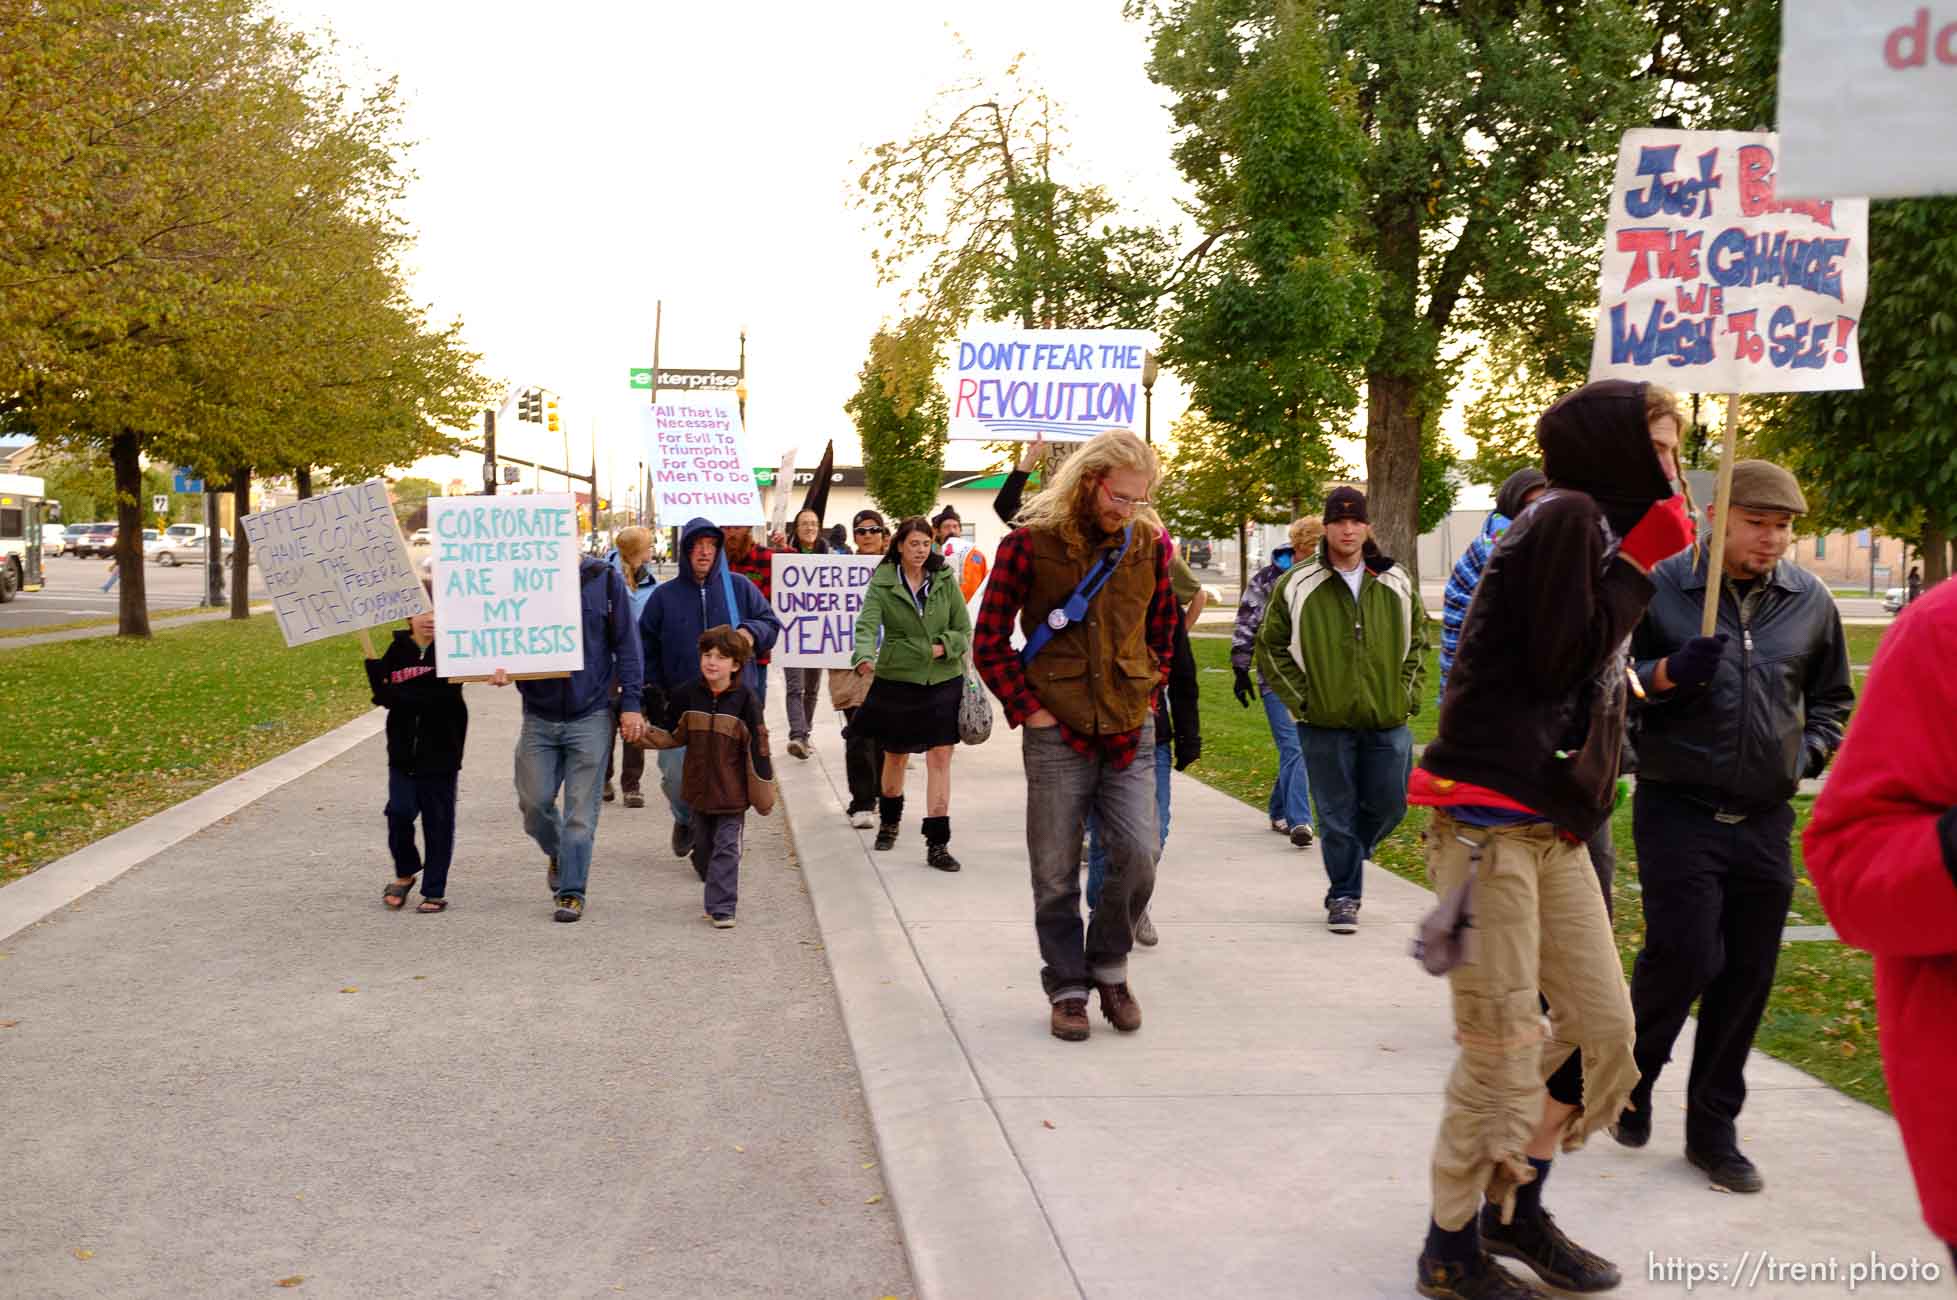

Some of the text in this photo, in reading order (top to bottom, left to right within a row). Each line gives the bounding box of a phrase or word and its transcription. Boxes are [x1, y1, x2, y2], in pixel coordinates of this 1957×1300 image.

[1616, 227, 1704, 294] THE
[1676, 283, 1724, 316] WE
[958, 341, 1142, 371] DON'T FEAR THE
[678, 406, 712, 418] That
[715, 408, 728, 418] Is
[955, 378, 1137, 423] REVOLUTION
[656, 418, 730, 431] Necessary
[658, 432, 734, 444] For Evil To
[658, 444, 737, 457] Triumph Is
[662, 457, 740, 469] For Good
[656, 470, 749, 482] Men To Do
[247, 483, 388, 542] EFFECTIVE
[437, 507, 571, 539] CORPORATE
[319, 514, 393, 553] COMES
[440, 541, 560, 562] INTERESTS
[447, 568, 560, 597] ARE NOT
[782, 565, 876, 588] OVER ED
[483, 598, 528, 622] MY
[778, 591, 840, 613] UNDER
[448, 625, 576, 658] INTERESTS
